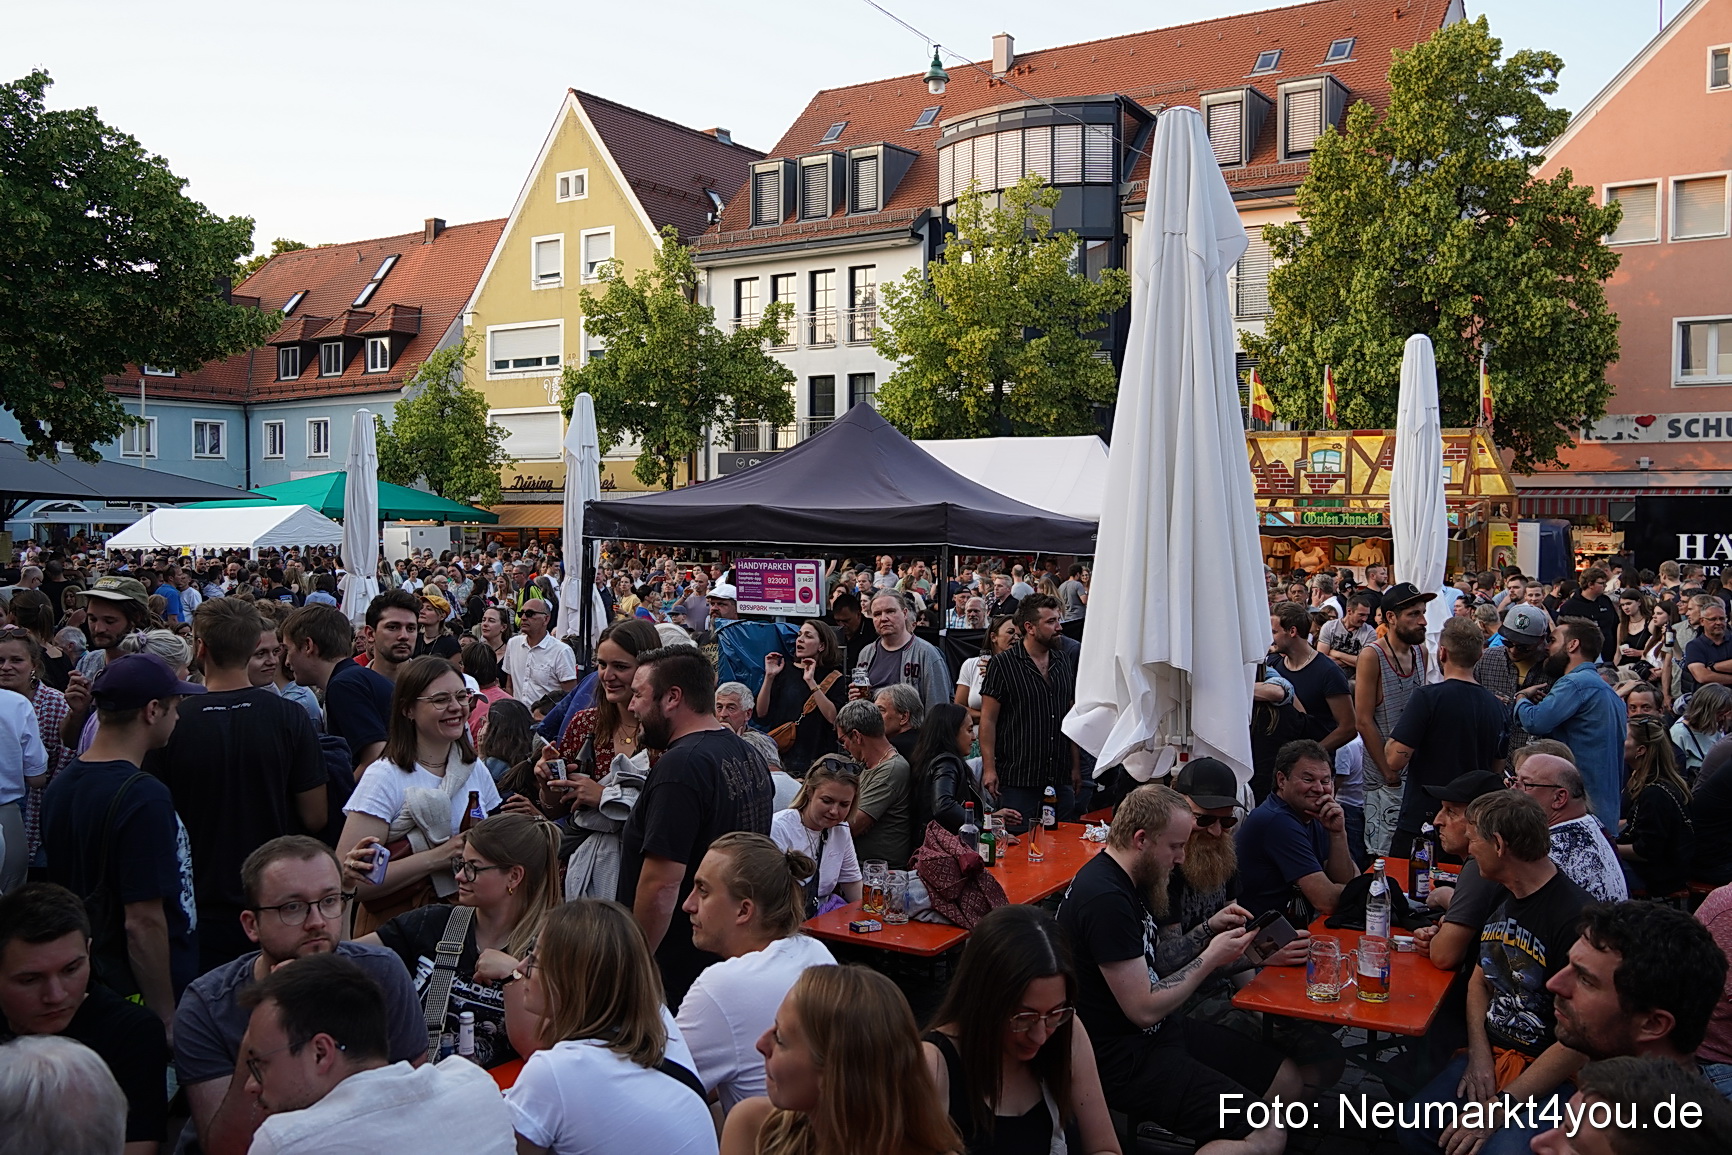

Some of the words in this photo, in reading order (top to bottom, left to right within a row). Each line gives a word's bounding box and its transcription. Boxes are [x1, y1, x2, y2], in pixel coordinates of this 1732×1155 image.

[510, 474, 554, 489] Düring
[1303, 512, 1339, 525] Guten
[737, 561, 793, 571] HANDYPARKEN
[767, 577, 789, 585] 923001
[1503, 917, 1547, 967] EAGLES
